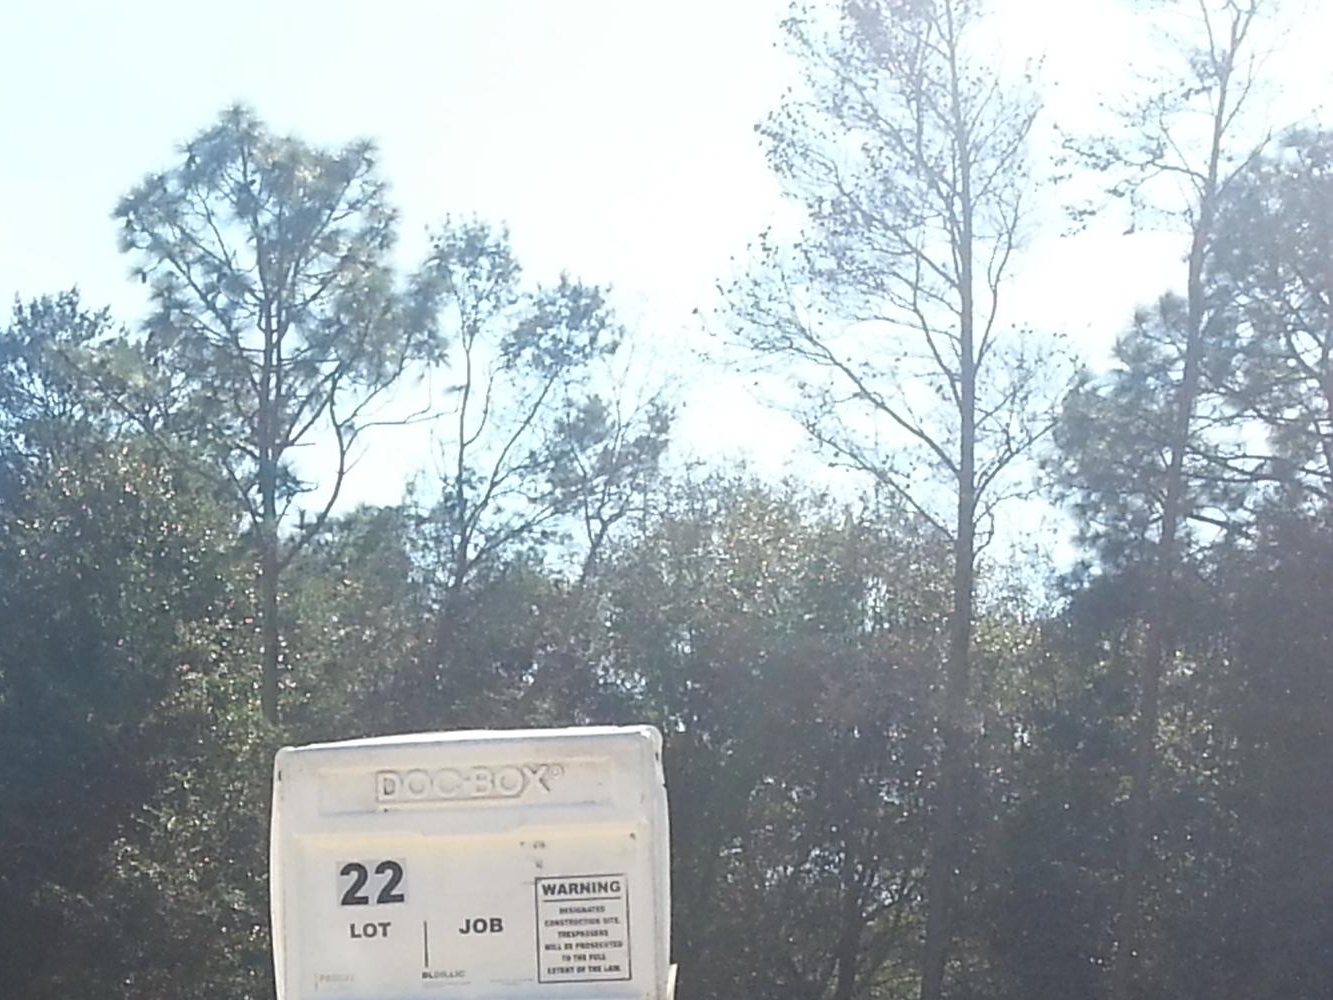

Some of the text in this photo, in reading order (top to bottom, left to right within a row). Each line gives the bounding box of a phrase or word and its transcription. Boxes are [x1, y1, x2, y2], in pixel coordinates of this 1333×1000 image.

[339, 859, 405, 906] 22
[541, 880, 622, 896] WARNING
[349, 922, 392, 939] LOT
[459, 918, 504, 934] JOB
